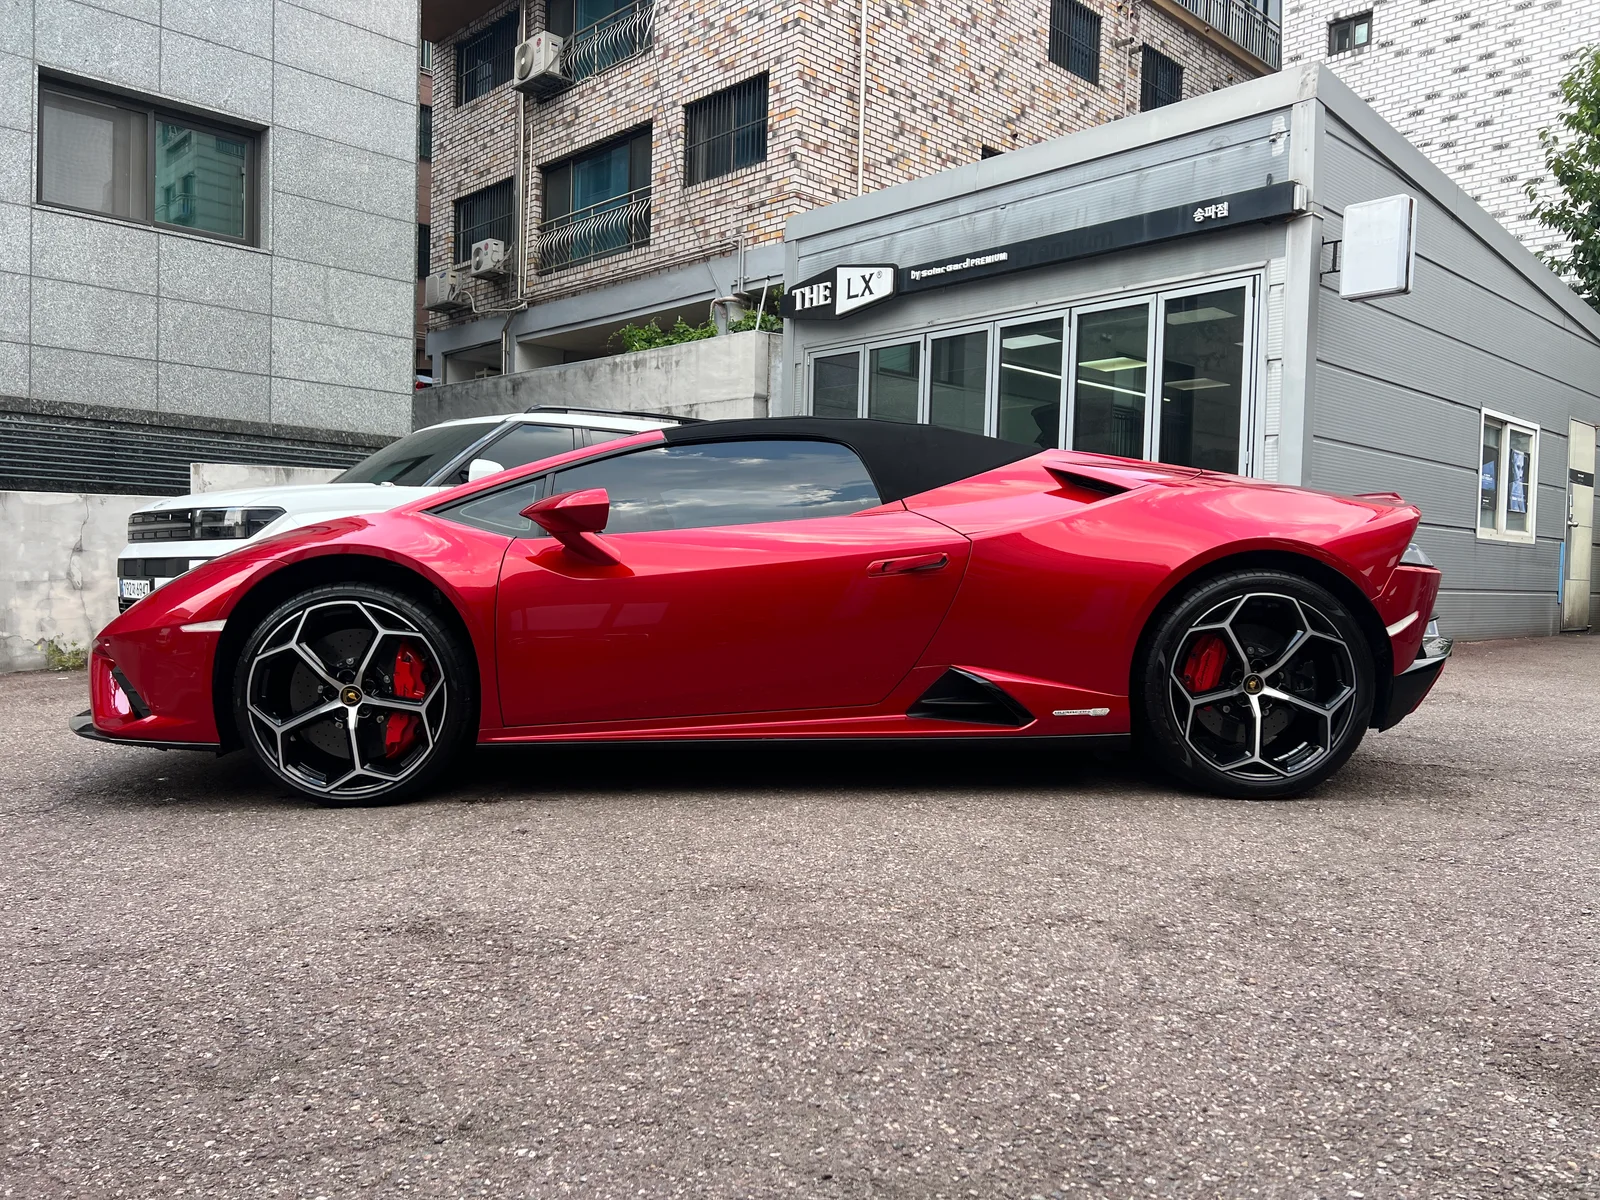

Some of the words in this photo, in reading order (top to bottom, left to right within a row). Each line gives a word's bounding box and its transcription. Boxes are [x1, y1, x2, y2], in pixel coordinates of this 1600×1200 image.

[1192, 201, 1229, 222] 송파점
[910, 270, 921, 281] by
[970, 252, 1008, 267] PREMIUM
[792, 281, 832, 311] THE
[846, 272, 875, 300] LX
